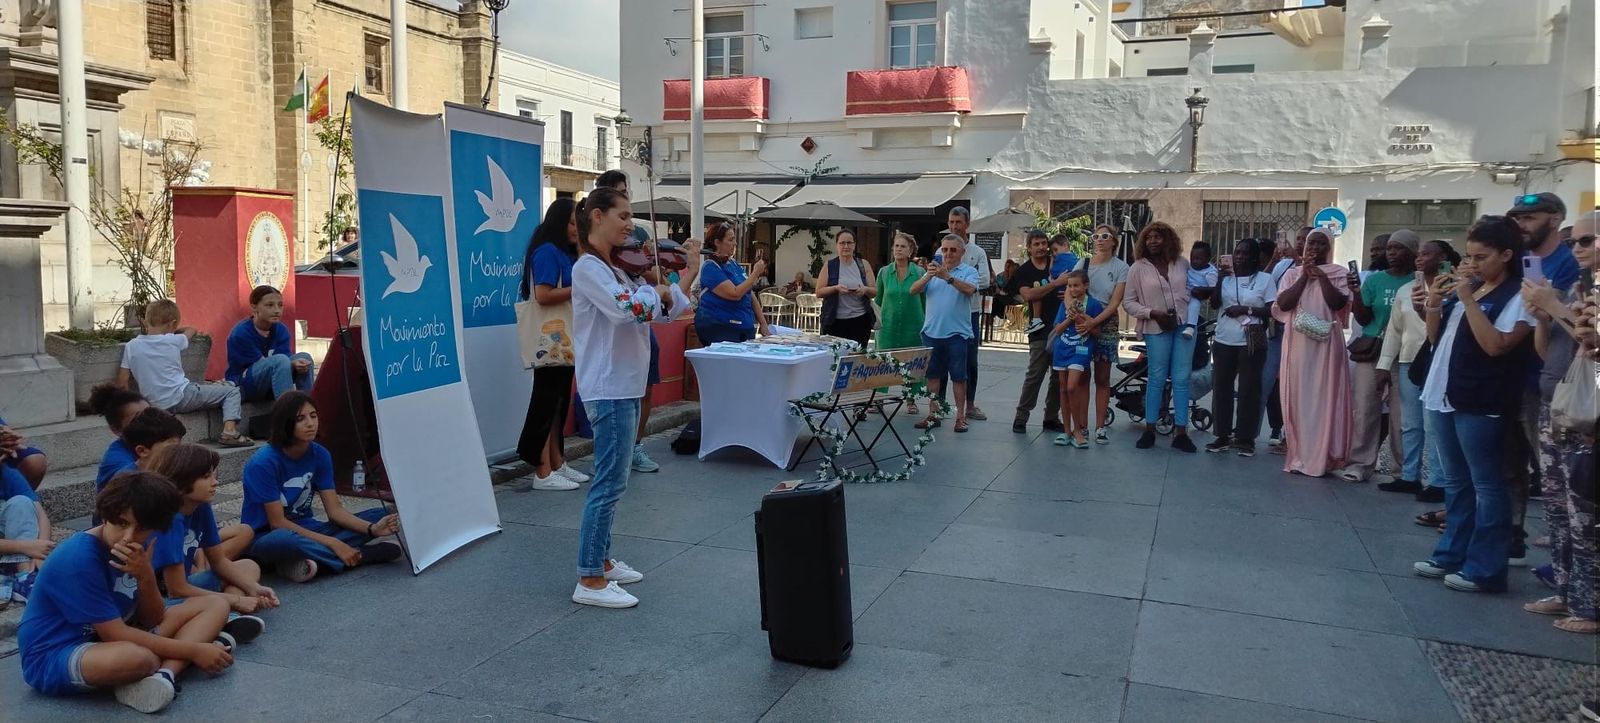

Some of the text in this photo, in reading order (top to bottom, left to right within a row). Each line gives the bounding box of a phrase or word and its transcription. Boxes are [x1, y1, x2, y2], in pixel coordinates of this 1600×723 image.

[1395, 124, 1431, 132] PLAZA
[469, 250, 526, 283] Movimien
[473, 289, 498, 317] por
[501, 283, 511, 306] la
[380, 313, 446, 350] Movimiento
[386, 341, 451, 387] por la Paz
